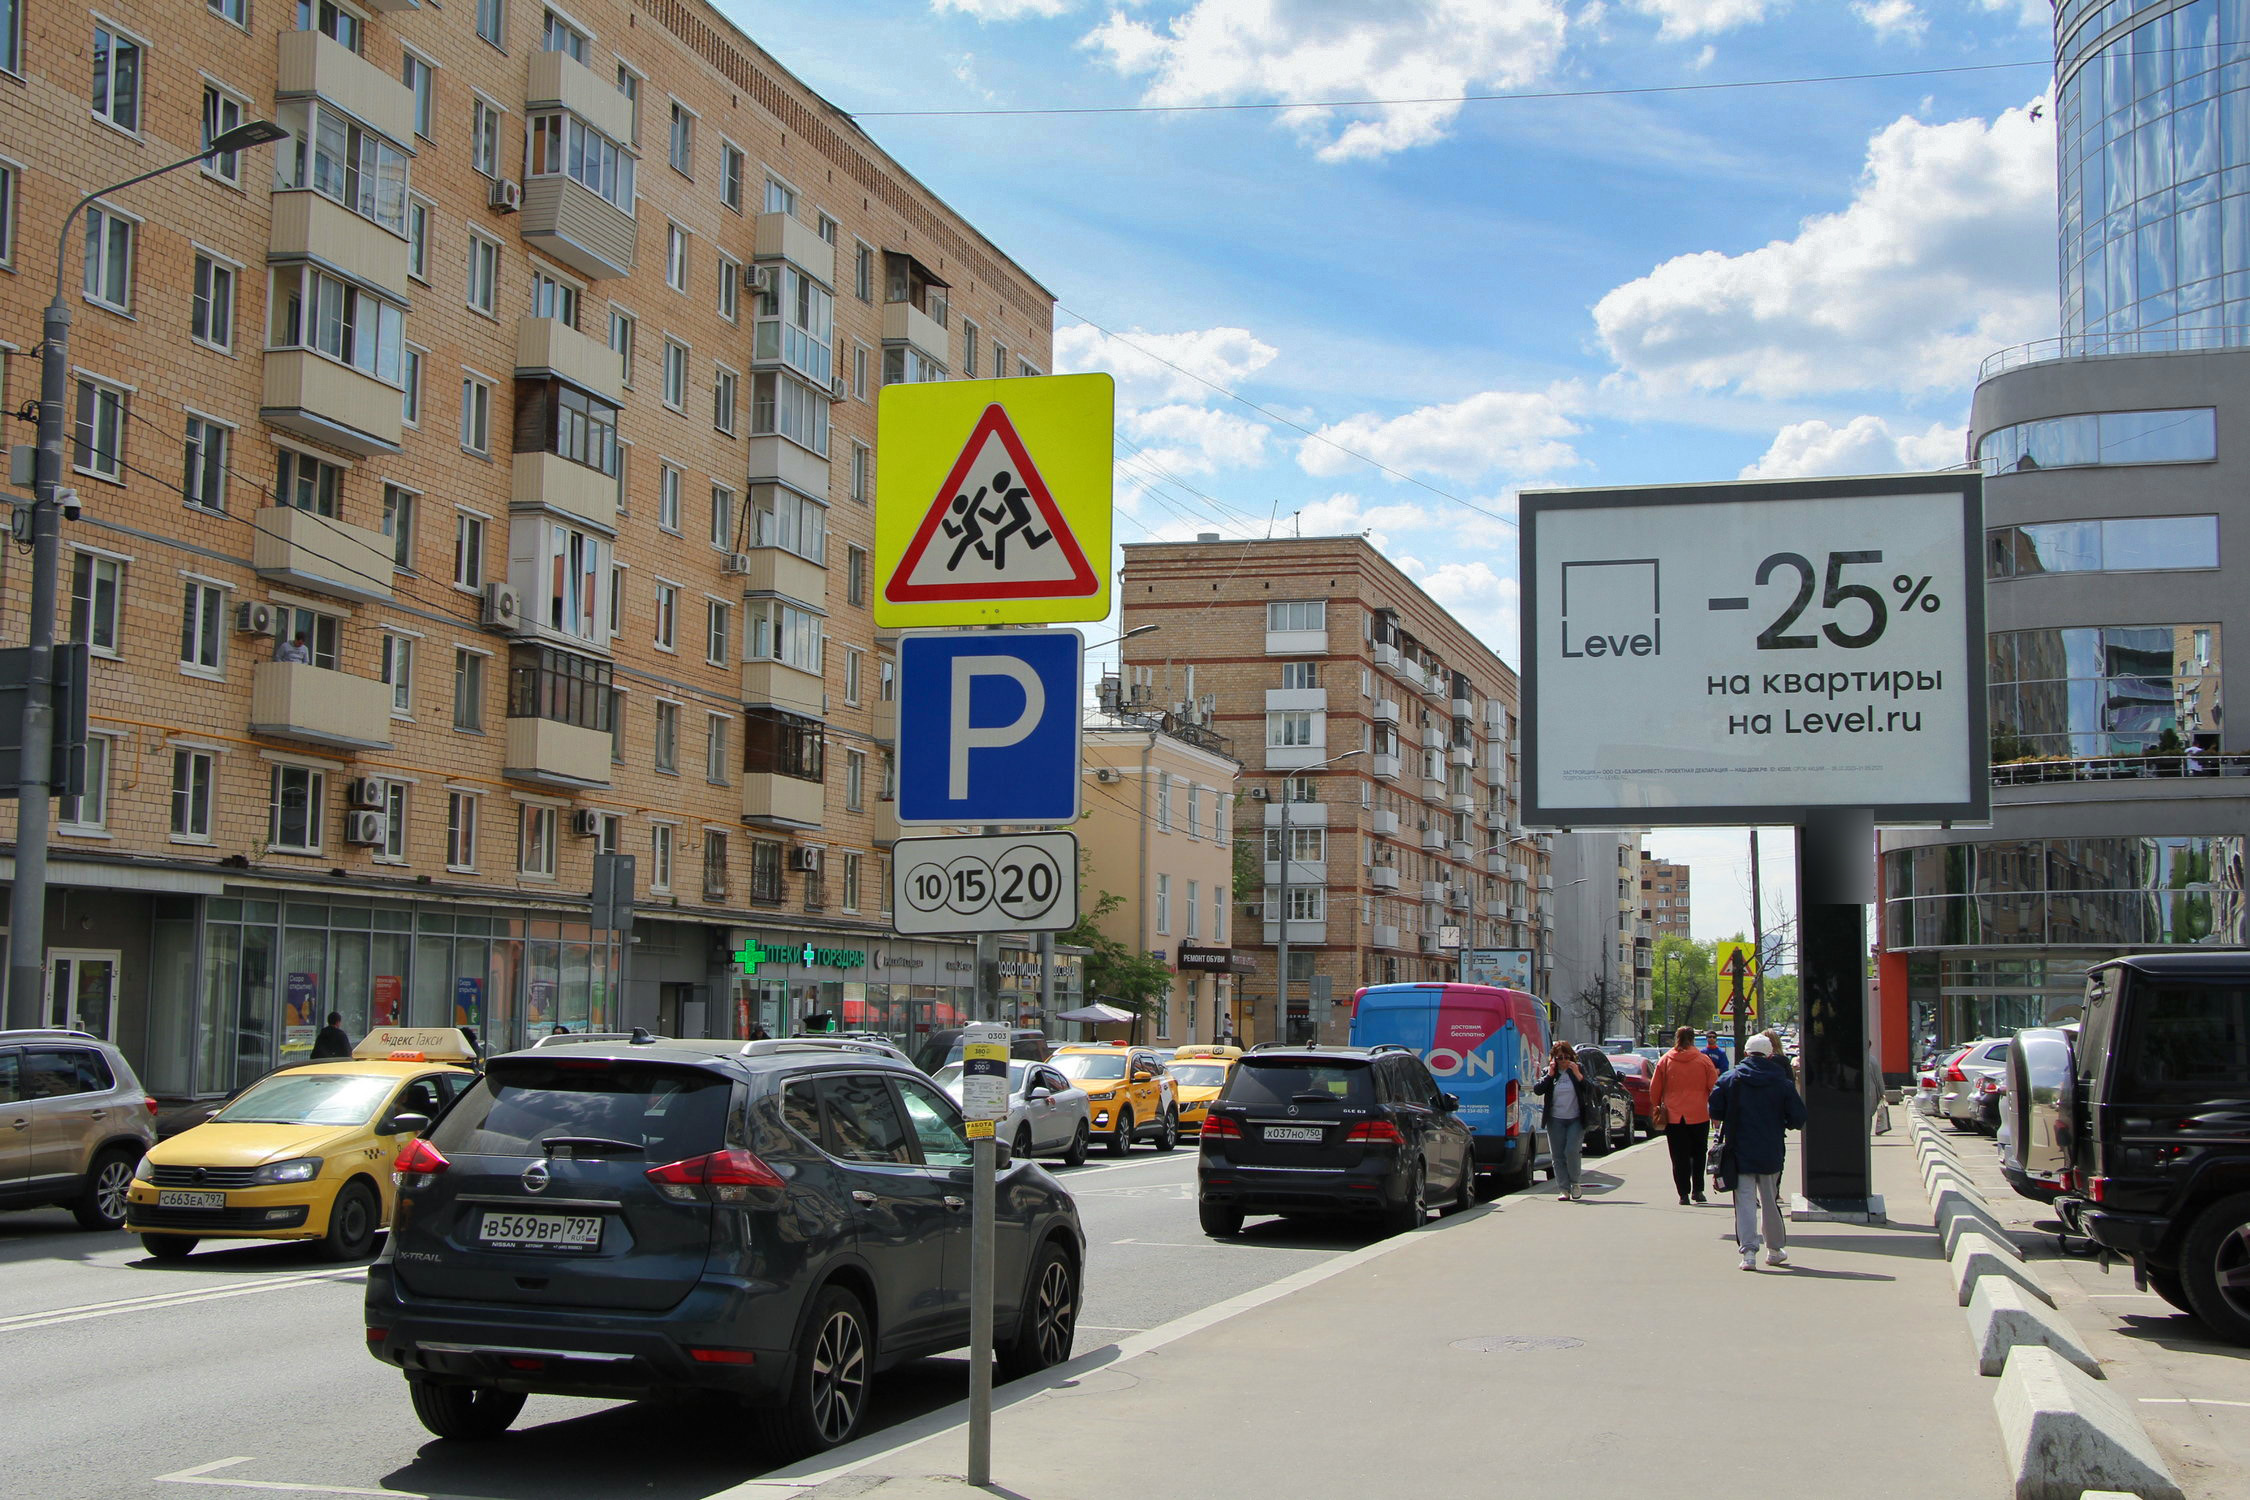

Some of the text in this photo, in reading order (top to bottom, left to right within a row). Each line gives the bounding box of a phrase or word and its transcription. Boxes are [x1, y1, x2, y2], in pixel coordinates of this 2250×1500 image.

[1707, 549, 1942, 651] -25%
[1562, 617, 1661, 658] Level
[1707, 669, 1943, 702] на квартиры
[1728, 704, 1923, 735] на Level.ru
[948, 654, 1045, 801] P
[915, 862, 1053, 904] 10 15 20
[817, 948, 865, 968] ГОРЗДРАВ
[1183, 954, 1206, 963] РЕМОНТ
[1206, 955, 1226, 963] ОБУВИ
[1017, 962, 1042, 977] ПИЦЦА
[380, 1032, 444, 1047] Яндекс Такси
[988, 1032, 1007, 1040] 0303
[1213, 1047, 1224, 1056] Go
[966, 1121, 993, 1129] РАБОТА
[1305, 1128, 1319, 1137] 750
[163, 1192, 221, 1206] С663ЕА 797
[487, 1216, 596, 1240] В569ВР 797
[571, 1234, 586, 1242] RUS
[400, 1251, 442, 1263] X-TRAIL
